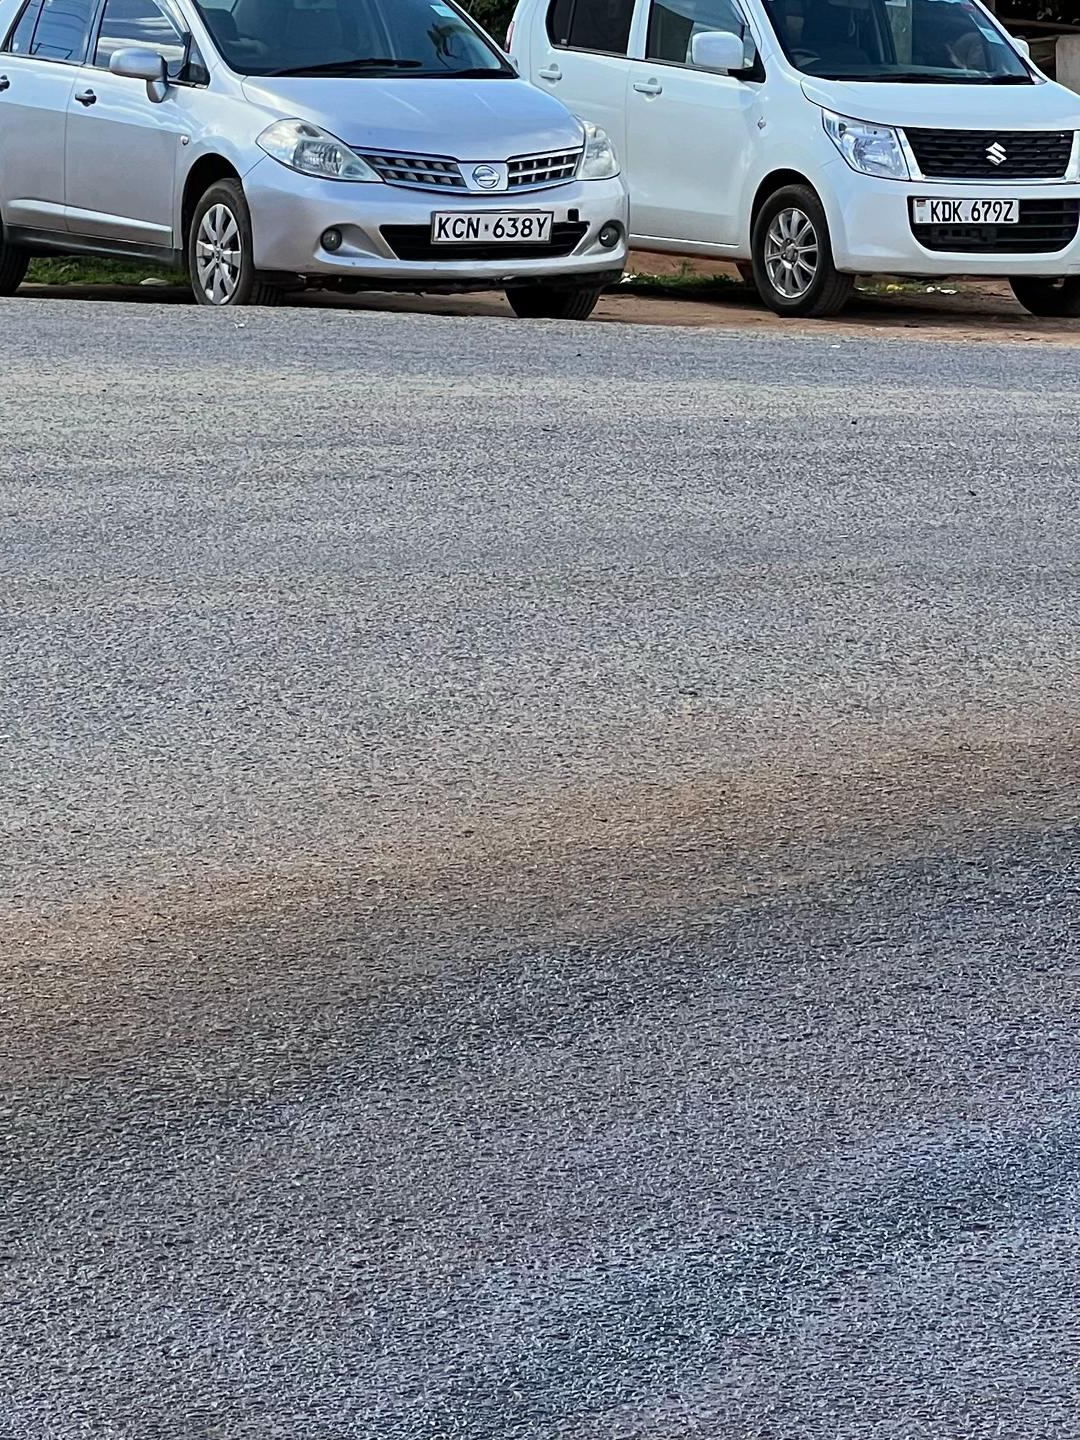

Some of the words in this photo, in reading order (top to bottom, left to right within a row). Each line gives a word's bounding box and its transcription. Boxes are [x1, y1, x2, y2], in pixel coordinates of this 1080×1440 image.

[930, 201, 963, 222] KDK
[971, 201, 1014, 222] 679Z
[437, 217, 480, 239] KCN
[492, 217, 548, 239] 638Y
